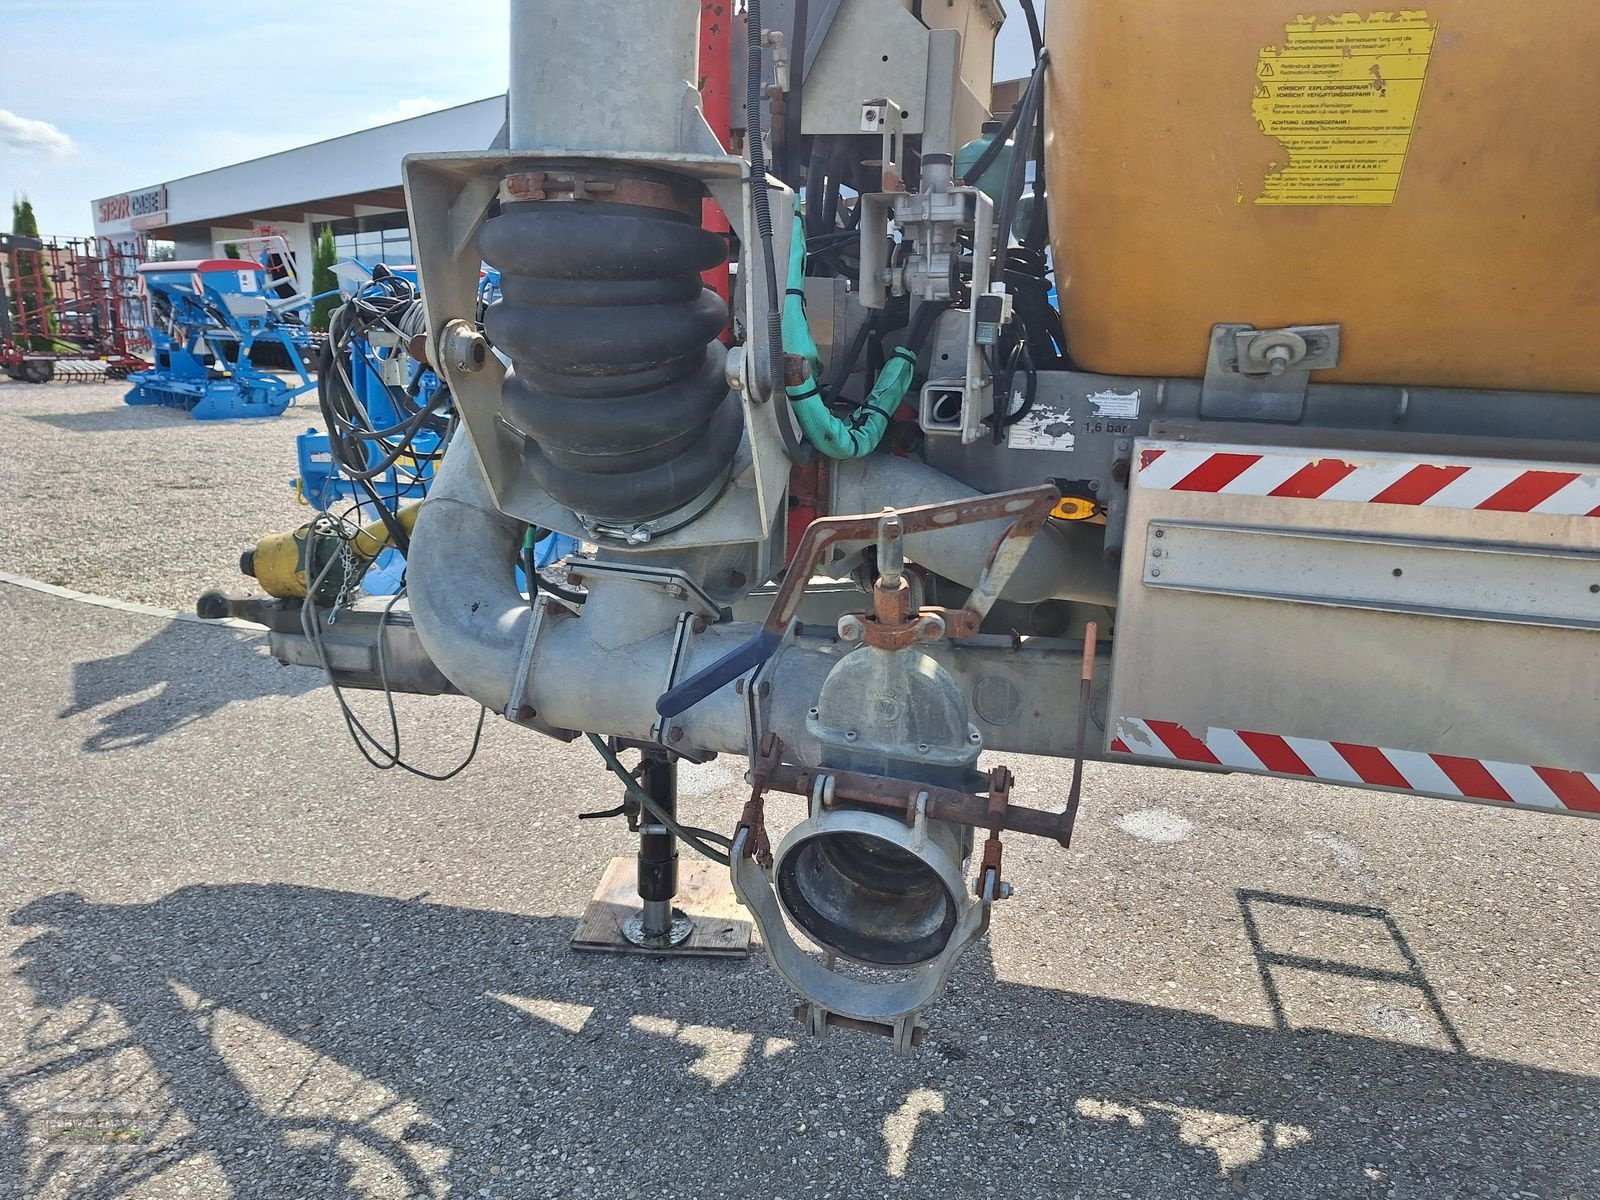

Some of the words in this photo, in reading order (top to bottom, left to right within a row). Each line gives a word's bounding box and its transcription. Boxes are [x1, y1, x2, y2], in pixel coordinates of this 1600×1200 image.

[97, 195, 130, 223] STEYR
[131, 191, 159, 216] CASE
[1085, 421, 1102, 433] 1,6
[1106, 422, 1127, 433] bar
